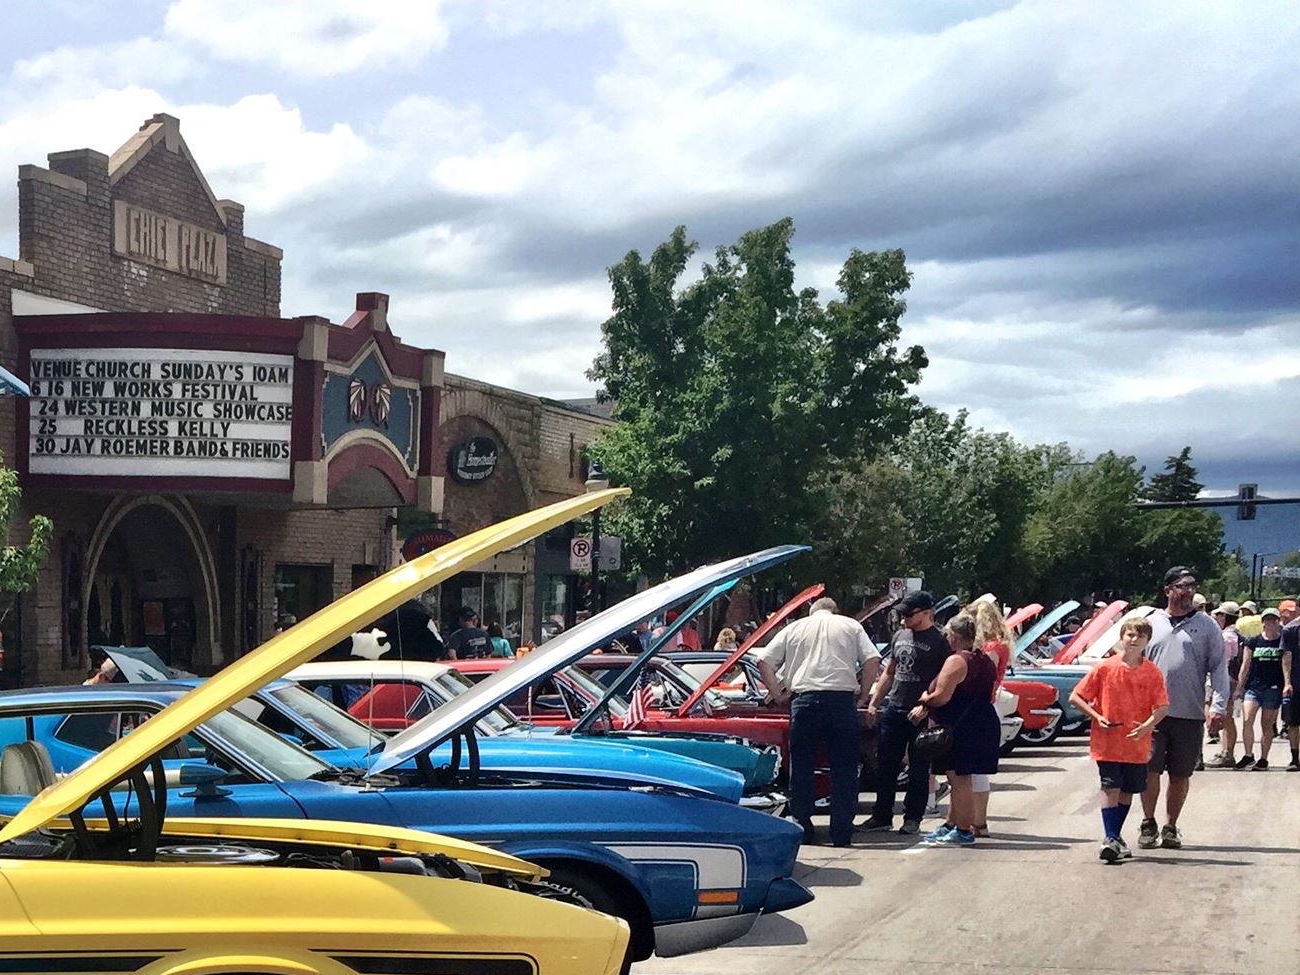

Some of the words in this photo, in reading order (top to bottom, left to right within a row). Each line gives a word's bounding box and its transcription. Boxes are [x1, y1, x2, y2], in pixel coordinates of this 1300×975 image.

[32, 360, 82, 378] VENUE
[85, 361, 151, 379] CHURCH
[160, 362, 244, 381] SUNDAY'S
[252, 365, 289, 383] 10AM
[31, 380, 41, 397] 6
[47, 380, 64, 397] 16
[71, 381, 105, 397] NEW
[113, 381, 173, 398] WORKS
[181, 382, 258, 401] FESTIVAL
[39, 399, 59, 416] 24
[64, 400, 141, 417] WESTERN
[151, 401, 203, 418] MUSIC
[213, 402, 292, 421] SHOWCASE
[38, 419, 57, 435] 25
[84, 419, 169, 436] RECKLESS
[178, 420, 230, 438] KELLY
[36, 438, 56, 454] 30
[60, 438, 95, 455] JAY
[101, 439, 170, 456] ROEMER
[232, 442, 289, 459] FRIENDS
